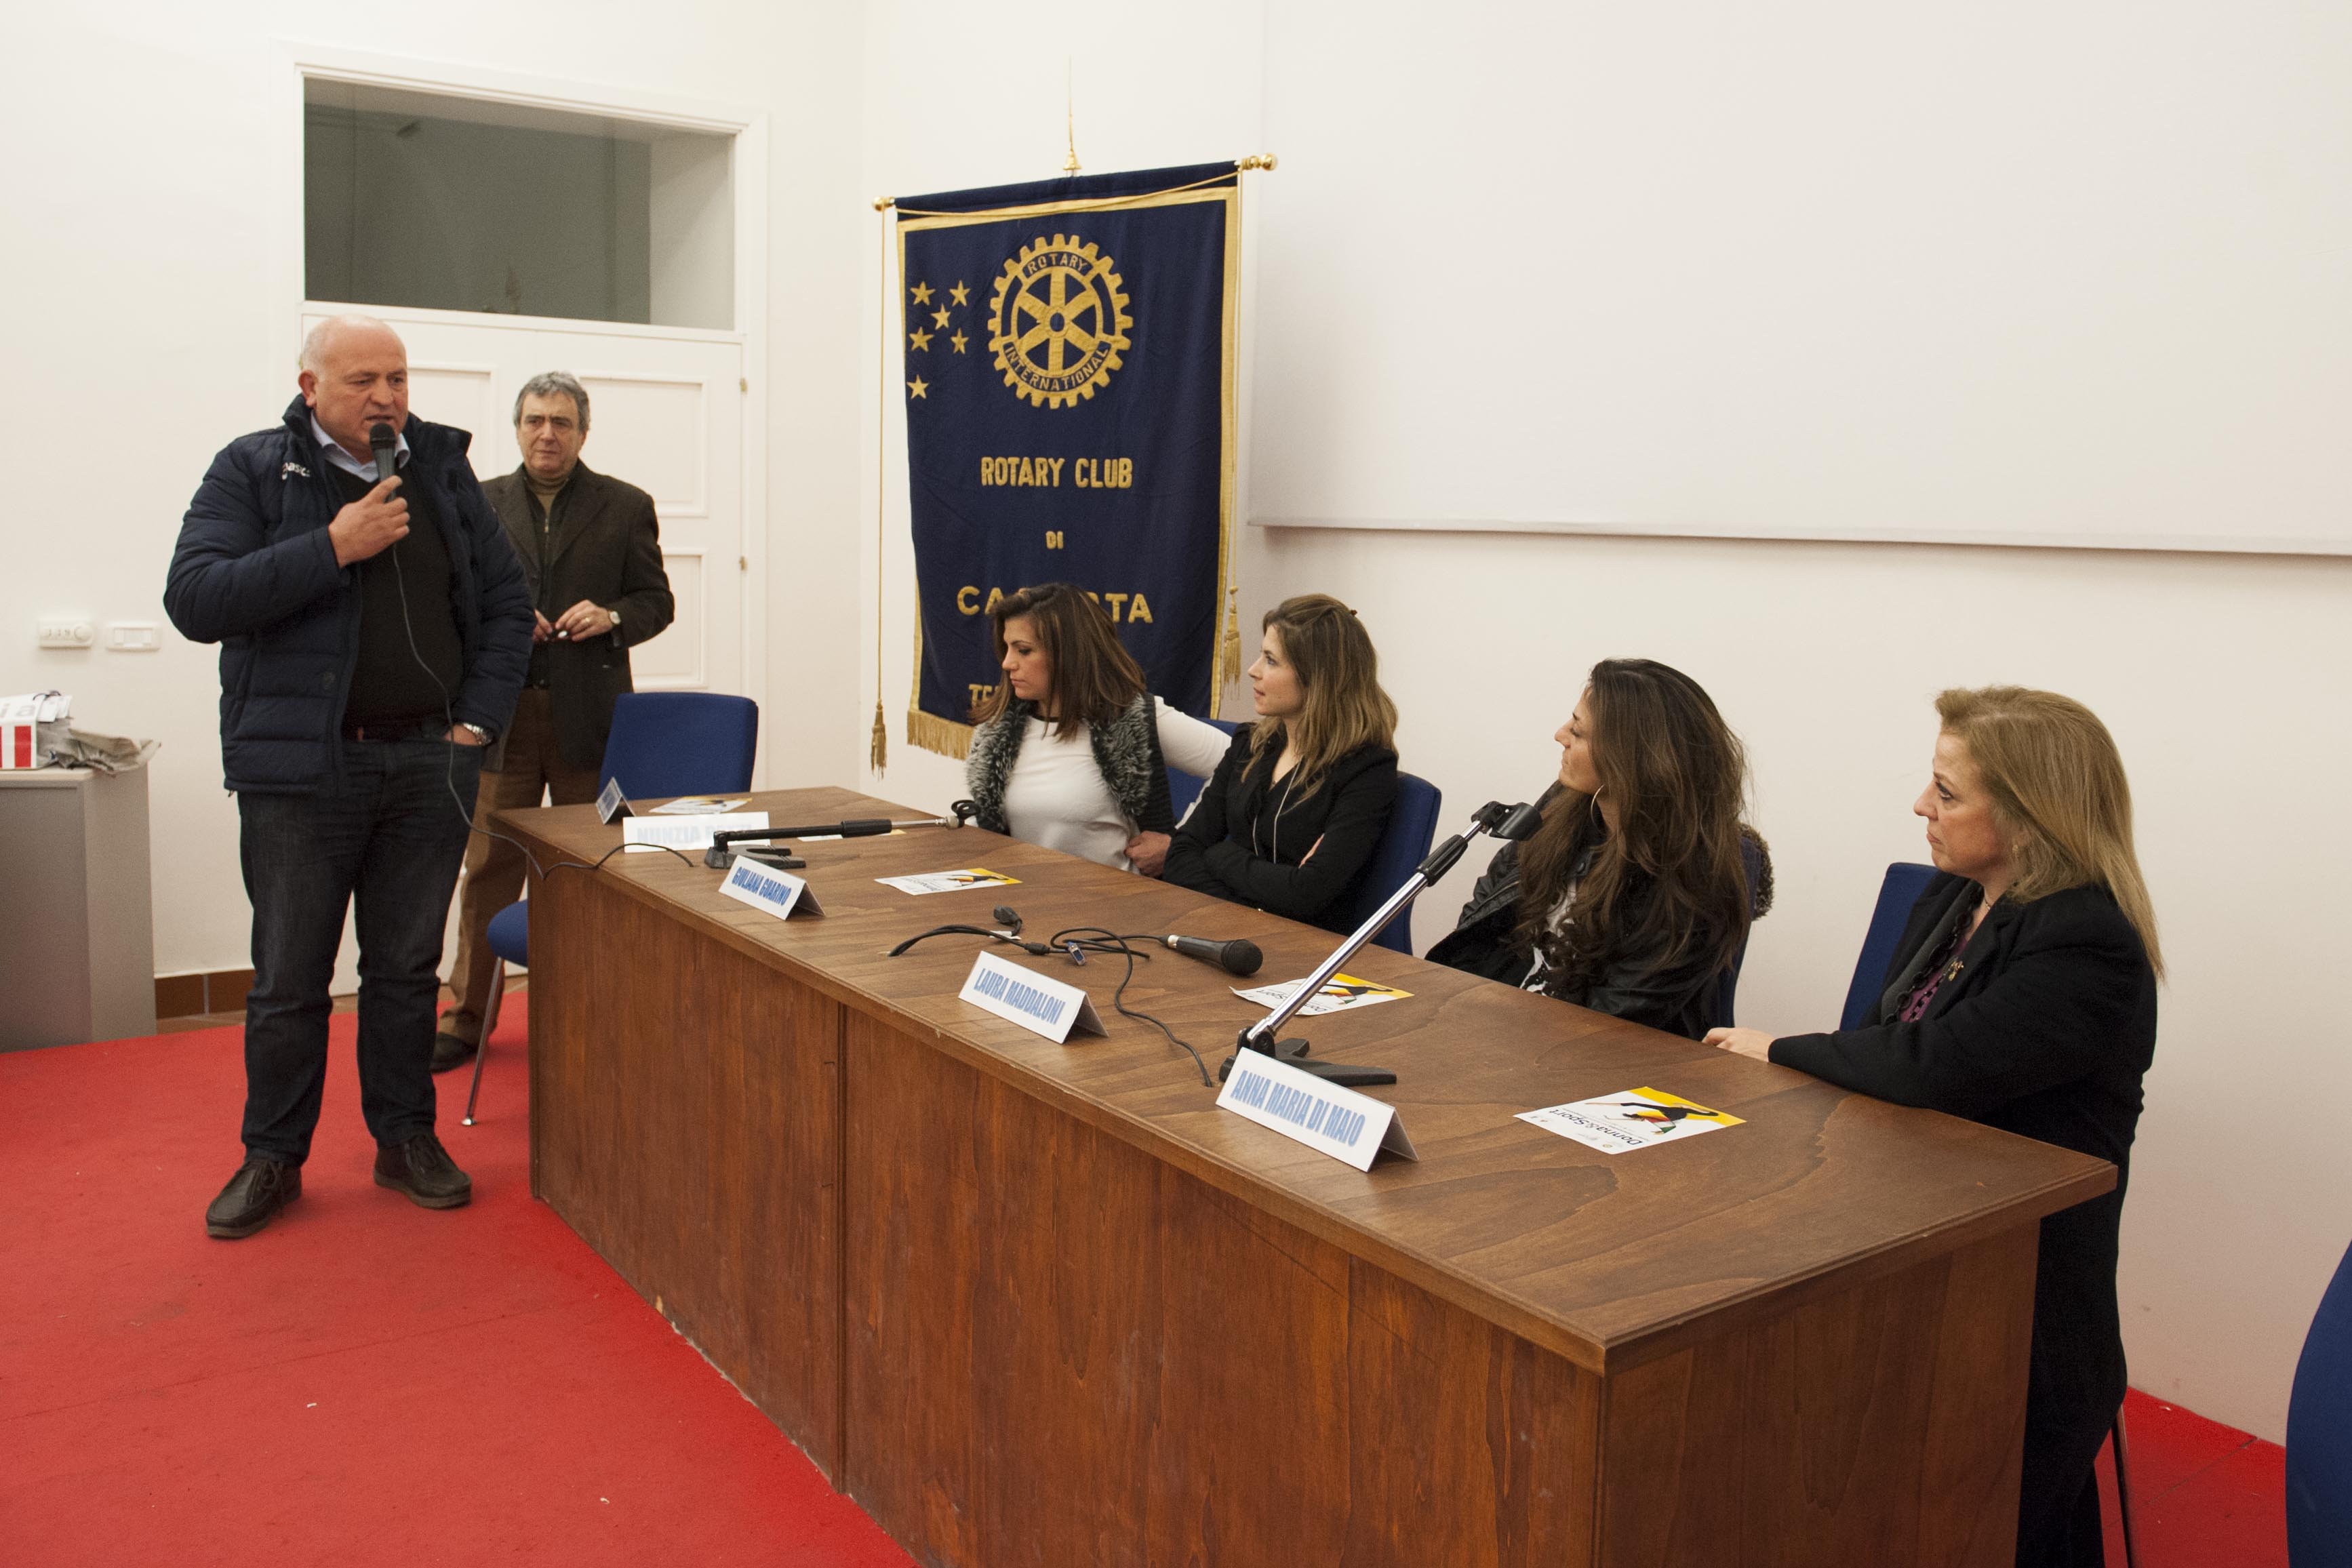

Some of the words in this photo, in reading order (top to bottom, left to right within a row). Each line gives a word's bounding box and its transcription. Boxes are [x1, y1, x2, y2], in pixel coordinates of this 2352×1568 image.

[1026, 253, 1088, 275] ROTARY
[1004, 346, 1109, 391] INTERNATIONAL
[980, 456, 1066, 487] ROTARY
[1075, 458, 1133, 489] CLUB
[1045, 531, 1064, 550] DI
[957, 585, 1153, 624] CATA
[731, 866, 765, 895] GIULIANA
[758, 878, 792, 906] GUARINO
[973, 967, 1010, 1001] LAURA
[1003, 980, 1067, 1026] MADDALONI
[1230, 1069, 1272, 1110] ANNA
[1263, 1081, 1314, 1127] MARIA
[1305, 1098, 1331, 1133] DI
[1321, 1104, 1366, 1148] MAIO
